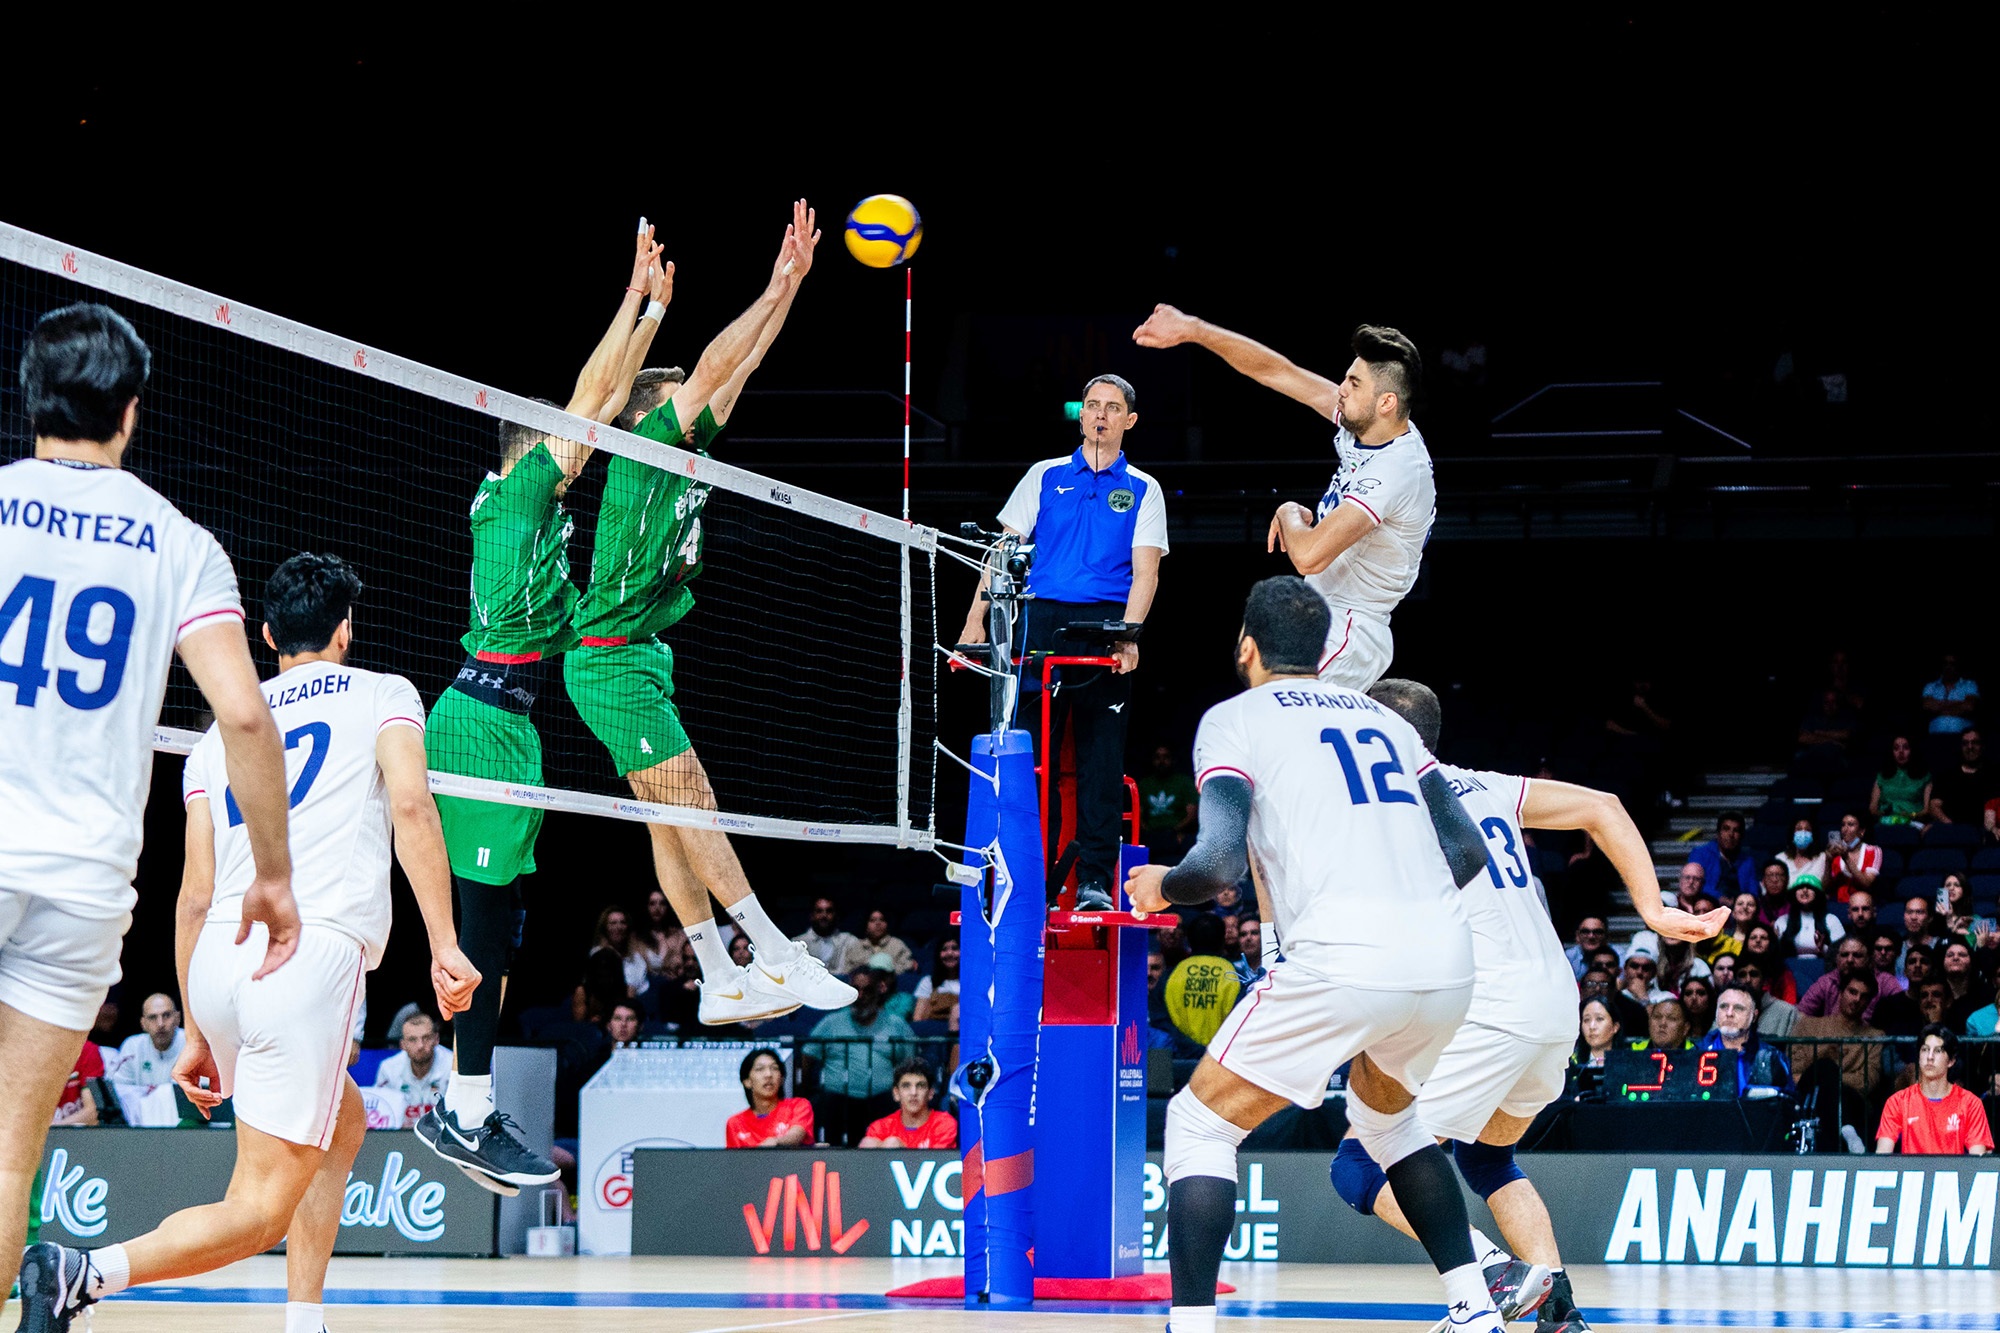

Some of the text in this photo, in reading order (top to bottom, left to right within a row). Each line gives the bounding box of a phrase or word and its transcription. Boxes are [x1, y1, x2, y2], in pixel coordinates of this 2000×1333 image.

[770, 487, 792, 504] MIKASA
[0, 498, 157, 553] MORTEZA
[0, 574, 136, 711] 49
[268, 674, 352, 709] LIZADEH
[641, 737, 653, 754] 4
[225, 721, 332, 828] 7
[1320, 727, 1420, 807] 12
[477, 847, 490, 867] 11
[1078, 915, 1103, 923] Senoh
[1185, 978, 1218, 992] SECURITY
[1187, 965, 1222, 977] CSC
[1183, 993, 1218, 1009] STAFF
[1698, 1052, 1718, 1086] 6
[742, 1160, 870, 1254] VNL
[1604, 1168, 1999, 1266] ANAHEIM
